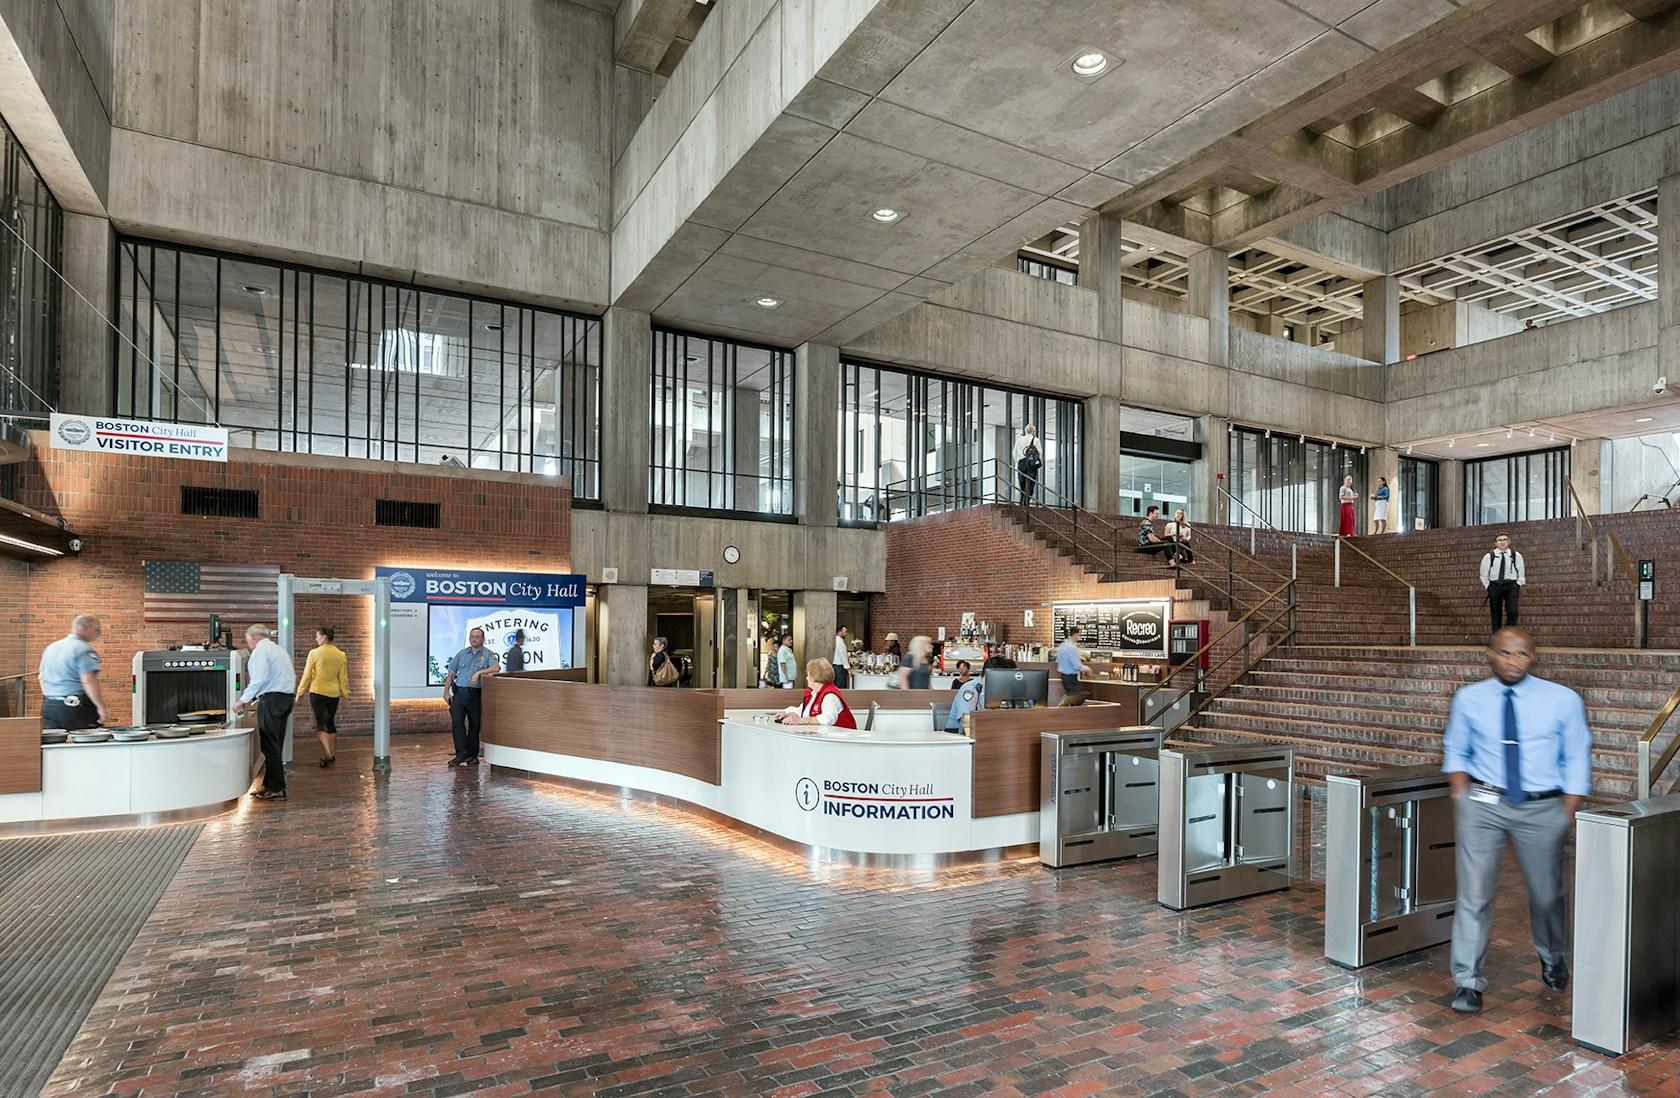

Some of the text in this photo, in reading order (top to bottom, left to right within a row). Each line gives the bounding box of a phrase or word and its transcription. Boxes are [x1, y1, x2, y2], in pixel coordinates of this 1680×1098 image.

[95, 421, 149, 434] BOSTON
[152, 426, 174, 439] City
[175, 429, 197, 438] Hall
[96, 437, 224, 457] VISITOR ENTRY
[426, 579, 507, 597] BOSTON
[510, 582, 542, 601] City
[547, 583, 579, 598] Hall
[479, 618, 550, 632] NTERING
[1126, 619, 1156, 636] Recreo
[824, 780, 934, 799] BOSTON City Hall
[824, 800, 954, 820] INFORMATION
